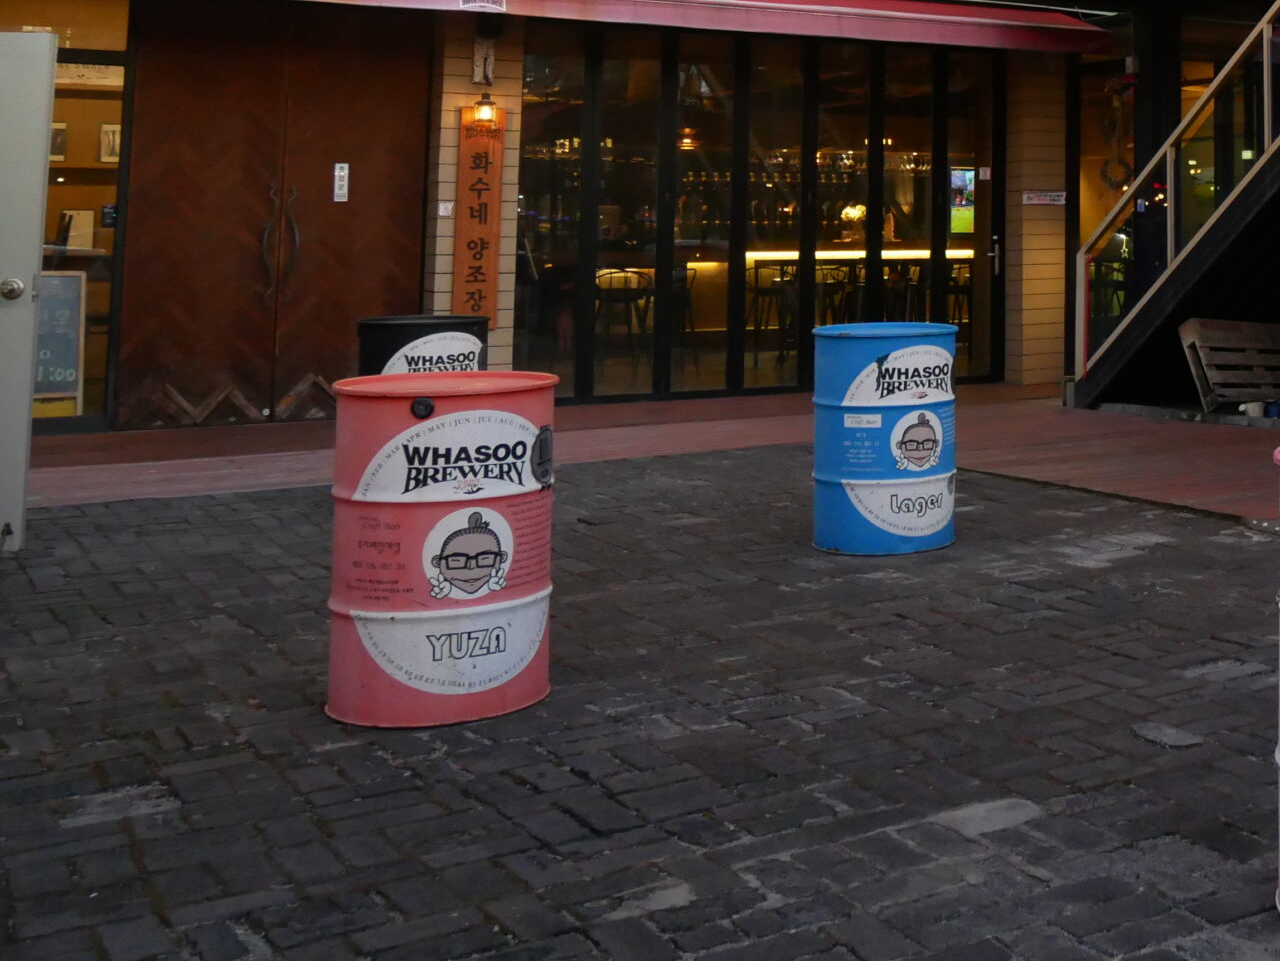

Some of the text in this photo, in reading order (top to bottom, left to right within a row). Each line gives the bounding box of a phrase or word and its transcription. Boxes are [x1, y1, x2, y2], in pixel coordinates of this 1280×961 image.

[464, 151, 493, 312] 화수네 양조장
[404, 351, 476, 367] WHASOO
[880, 363, 949, 380] WHASOO
[879, 376, 949, 399] BREWERY
[406, 432, 421, 445] APR
[427, 422, 446, 433] MAY
[454, 417, 470, 427] JUN
[478, 416, 492, 424] JUL
[498, 418, 514, 426] AUG
[401, 440, 527, 466] WHASOO
[401, 461, 526, 495] BREWERY
[890, 492, 943, 518] Lager
[426, 626, 506, 662] YUZA
